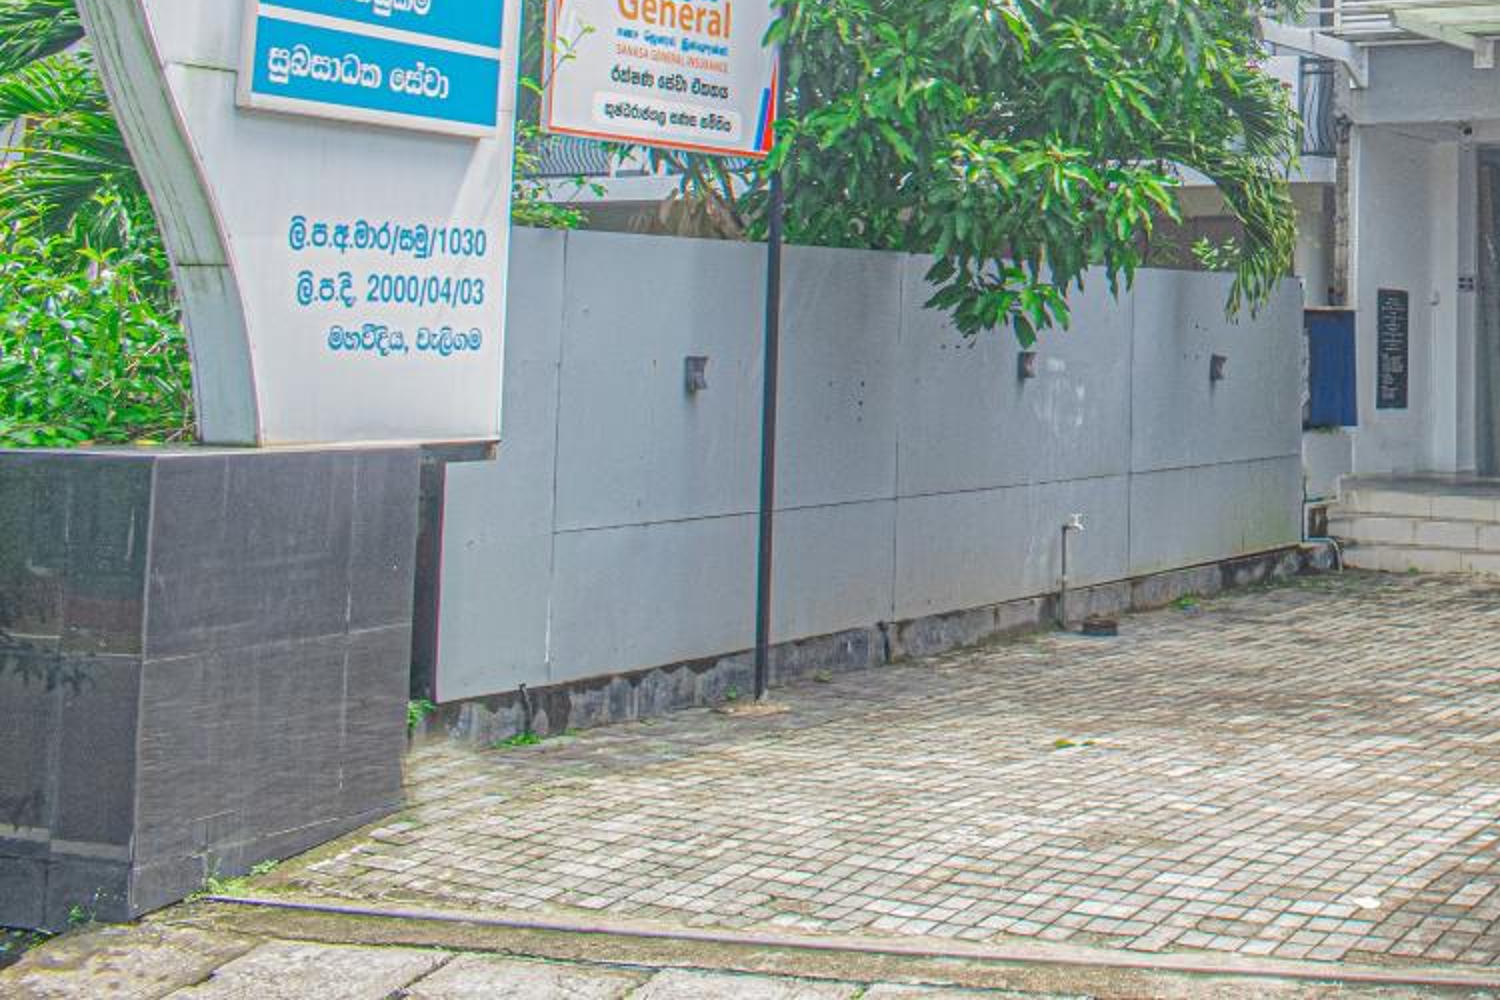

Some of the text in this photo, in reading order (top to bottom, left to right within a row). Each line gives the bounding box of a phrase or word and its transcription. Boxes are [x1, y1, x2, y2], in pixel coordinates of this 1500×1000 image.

[389, 61, 449, 100] සේවා
[366, 274, 485, 308] 2000/04/03
[416, 325, 482, 357] වැලිගම
